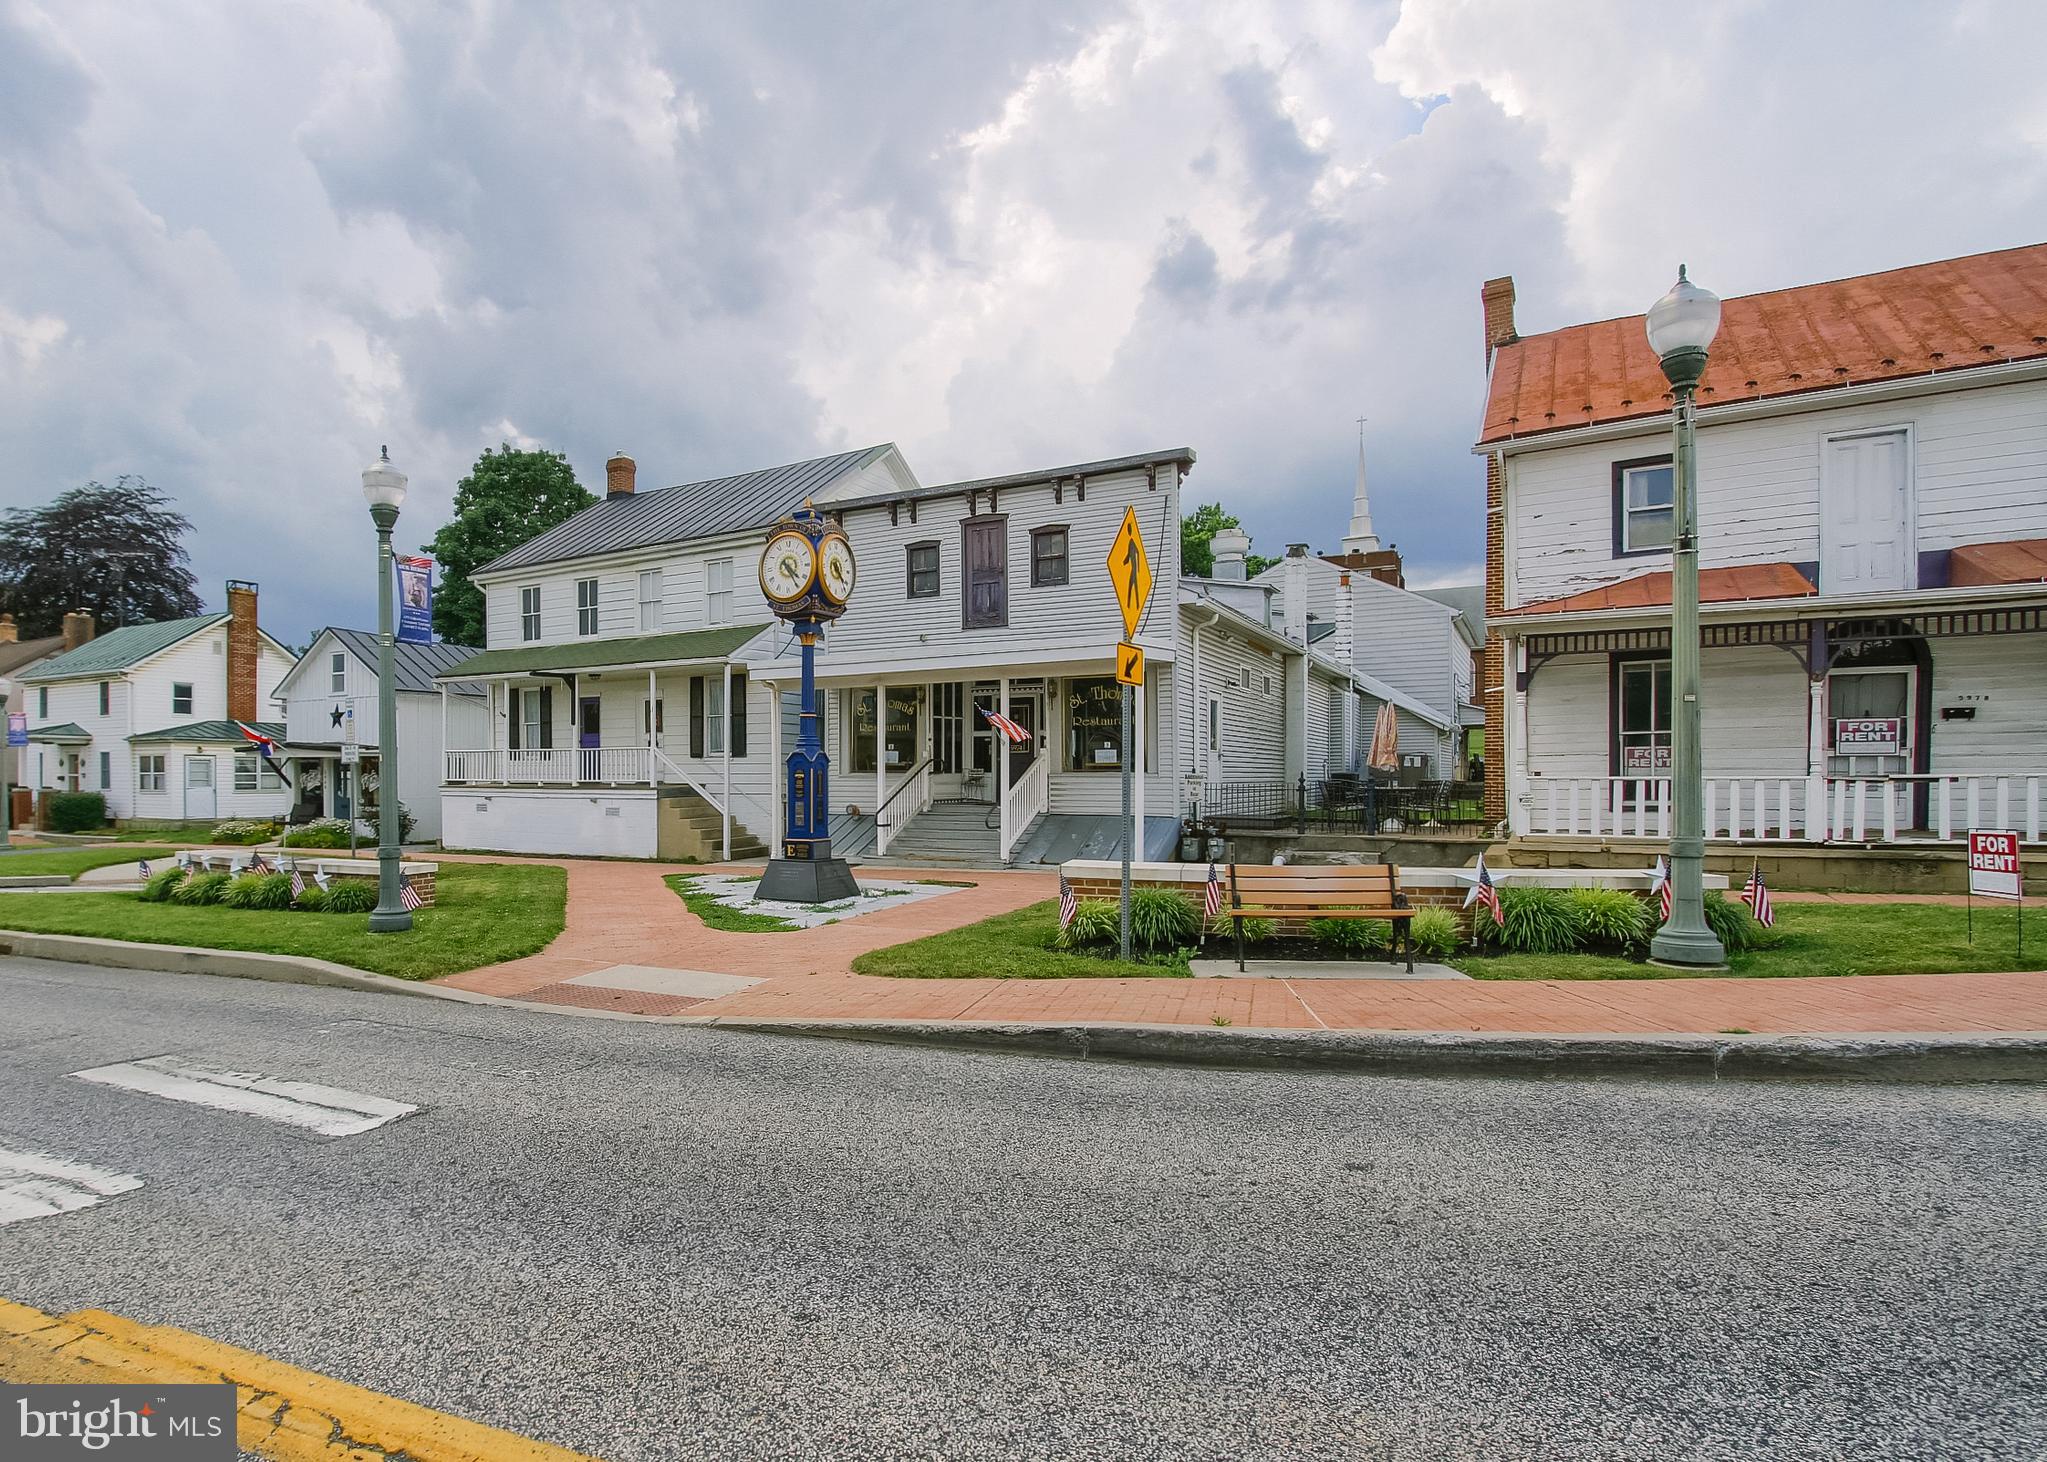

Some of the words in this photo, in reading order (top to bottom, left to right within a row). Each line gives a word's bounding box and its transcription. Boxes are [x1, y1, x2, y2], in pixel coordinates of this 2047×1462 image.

[1848, 722, 1888, 731] FOR
[1841, 732, 1895, 741] RENT
[1977, 836, 2009, 853] FOR
[1973, 853, 2015, 871] RENT
